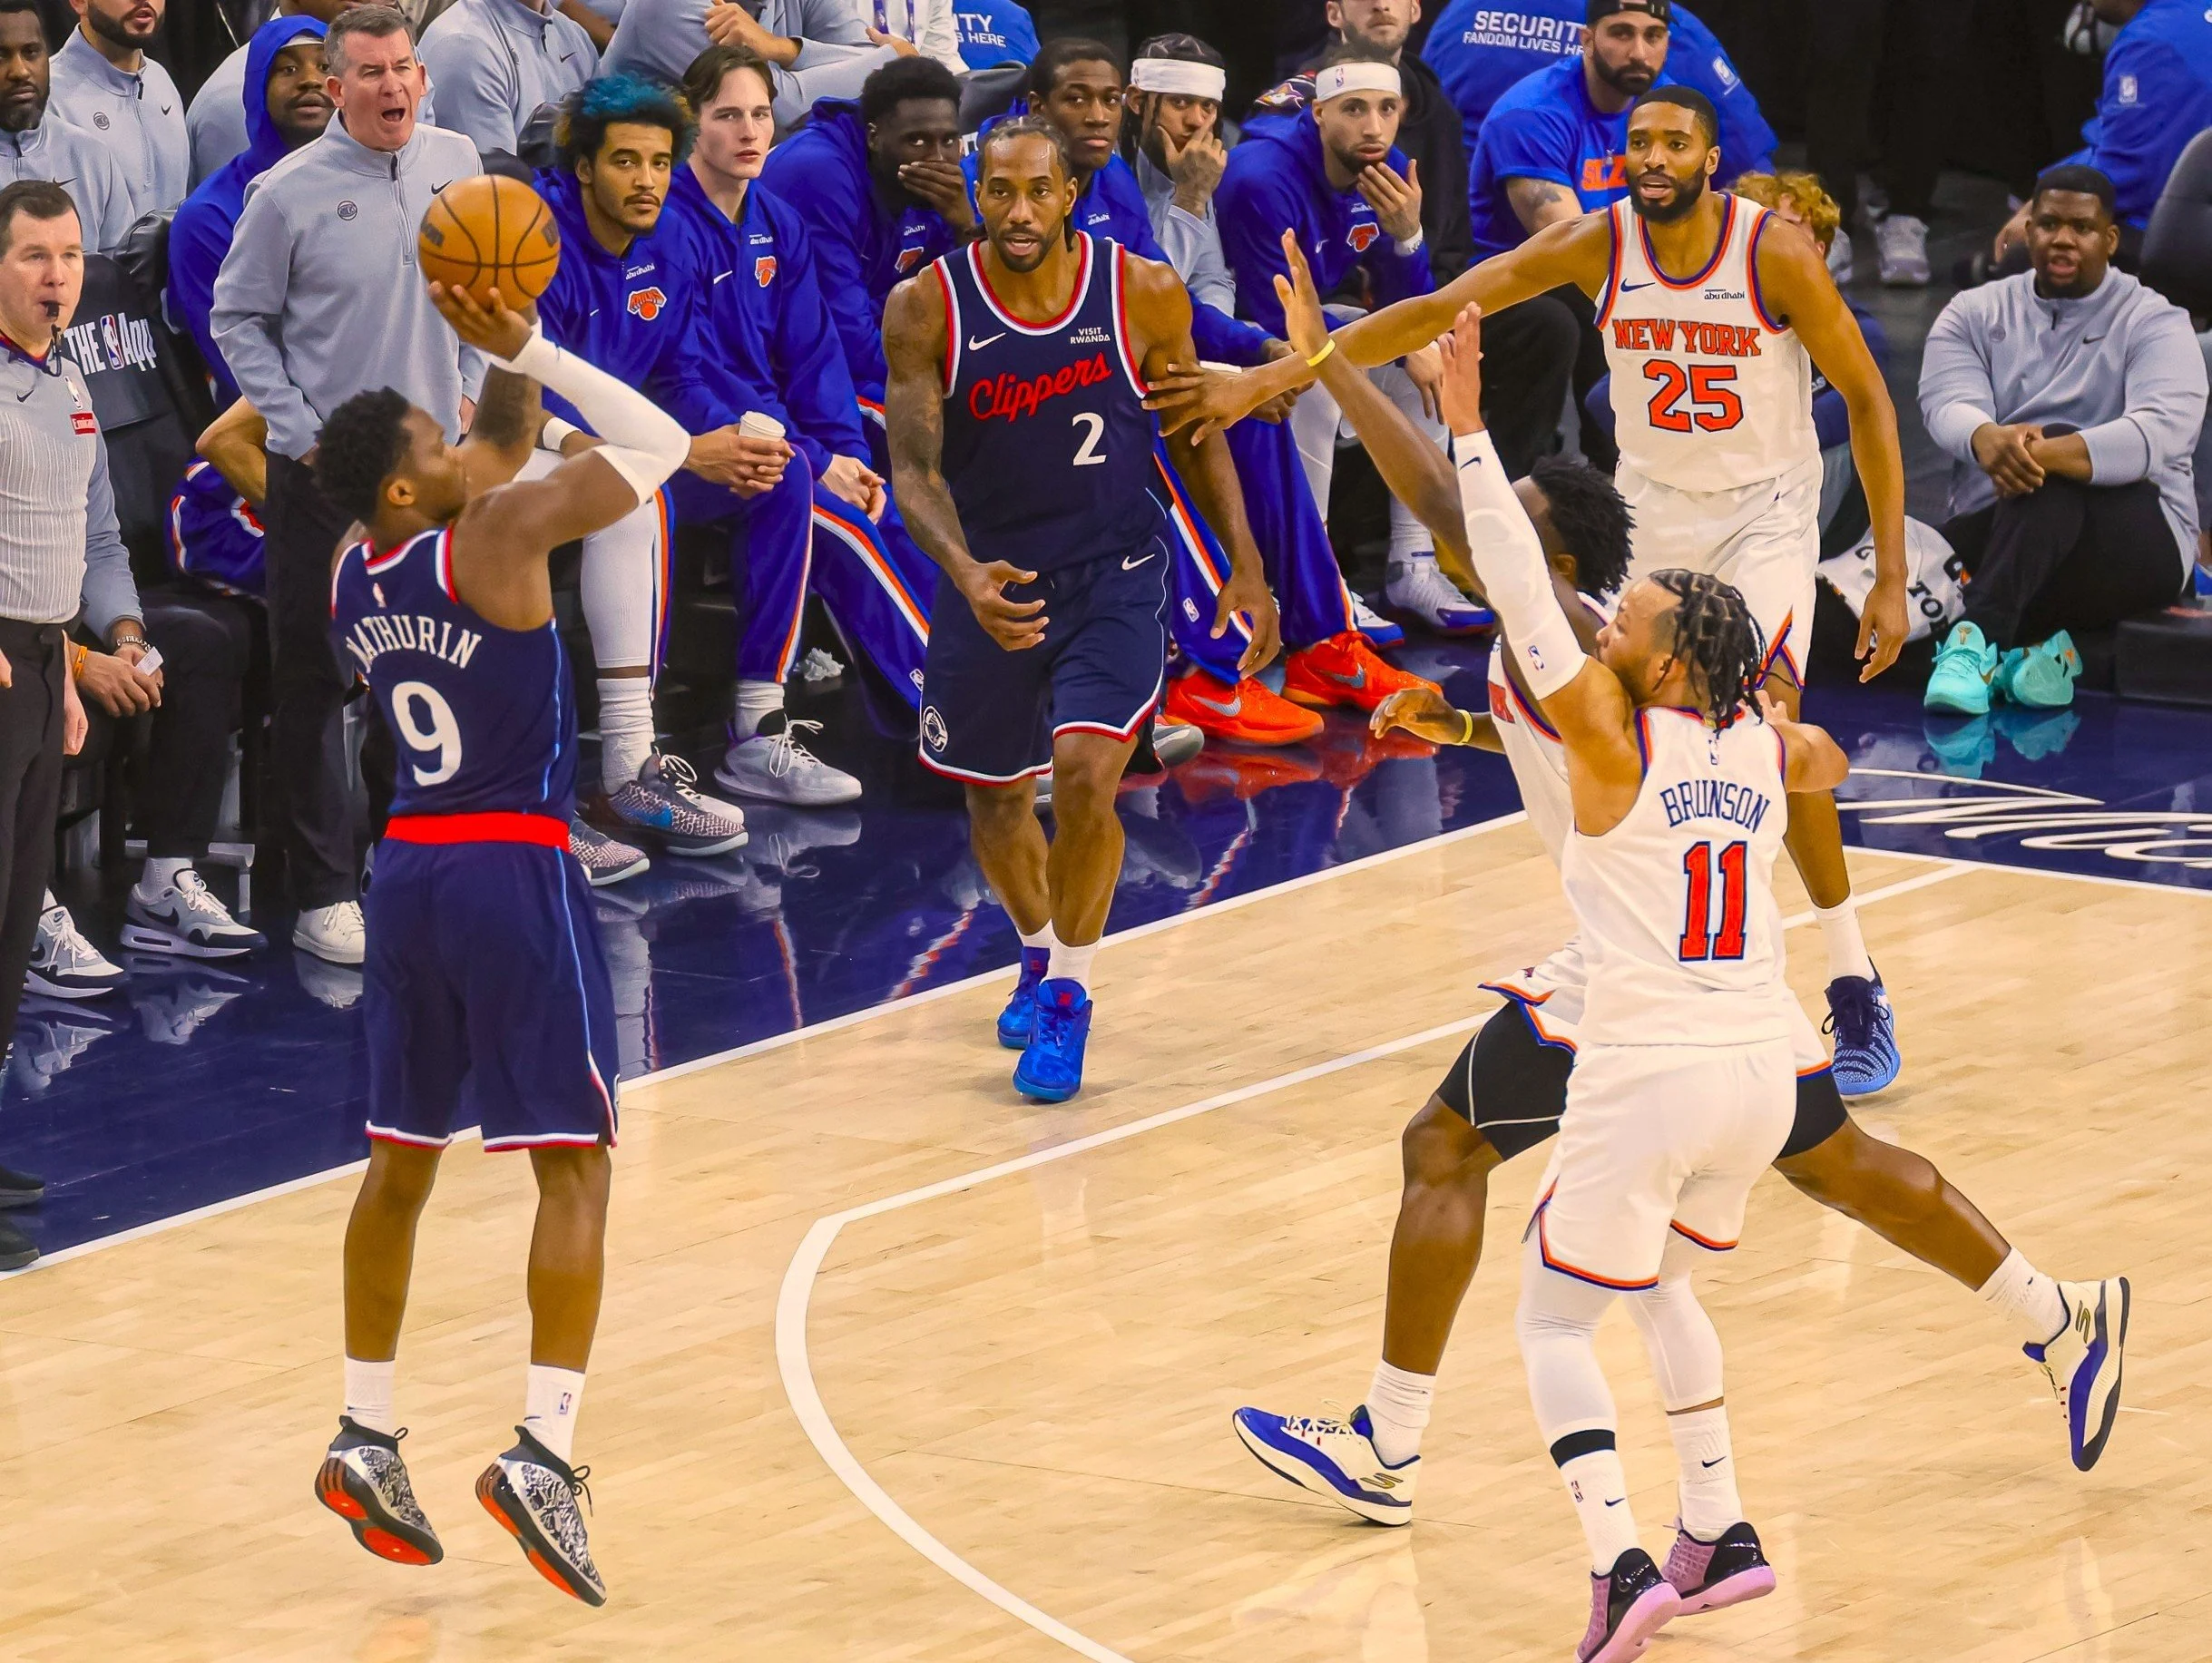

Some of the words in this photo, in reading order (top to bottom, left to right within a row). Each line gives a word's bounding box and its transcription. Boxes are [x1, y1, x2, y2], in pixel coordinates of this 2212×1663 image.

[968, 32, 1006, 48] HERE
[1463, 31, 1517, 48] FANDOM
[1518, 37, 1561, 54] LIVES
[1473, 10, 1588, 42] SECURIT
[1704, 291, 1720, 300] abu
[1721, 291, 1746, 299] dhabi
[64, 321, 107, 376] THE
[117, 312, 157, 372] App
[1070, 334, 1111, 345] RWANDA
[1077, 327, 1102, 336] VISIT
[1611, 318, 1677, 352] NEW
[1678, 320, 1762, 357] YORK
[968, 351, 1113, 423] Clippers
[1642, 358, 1744, 434] 25
[1072, 412, 1107, 466] 2
[391, 680, 463, 787] 9
[1659, 779, 1771, 834] BRUNSON
[1679, 840, 1747, 962] 11
